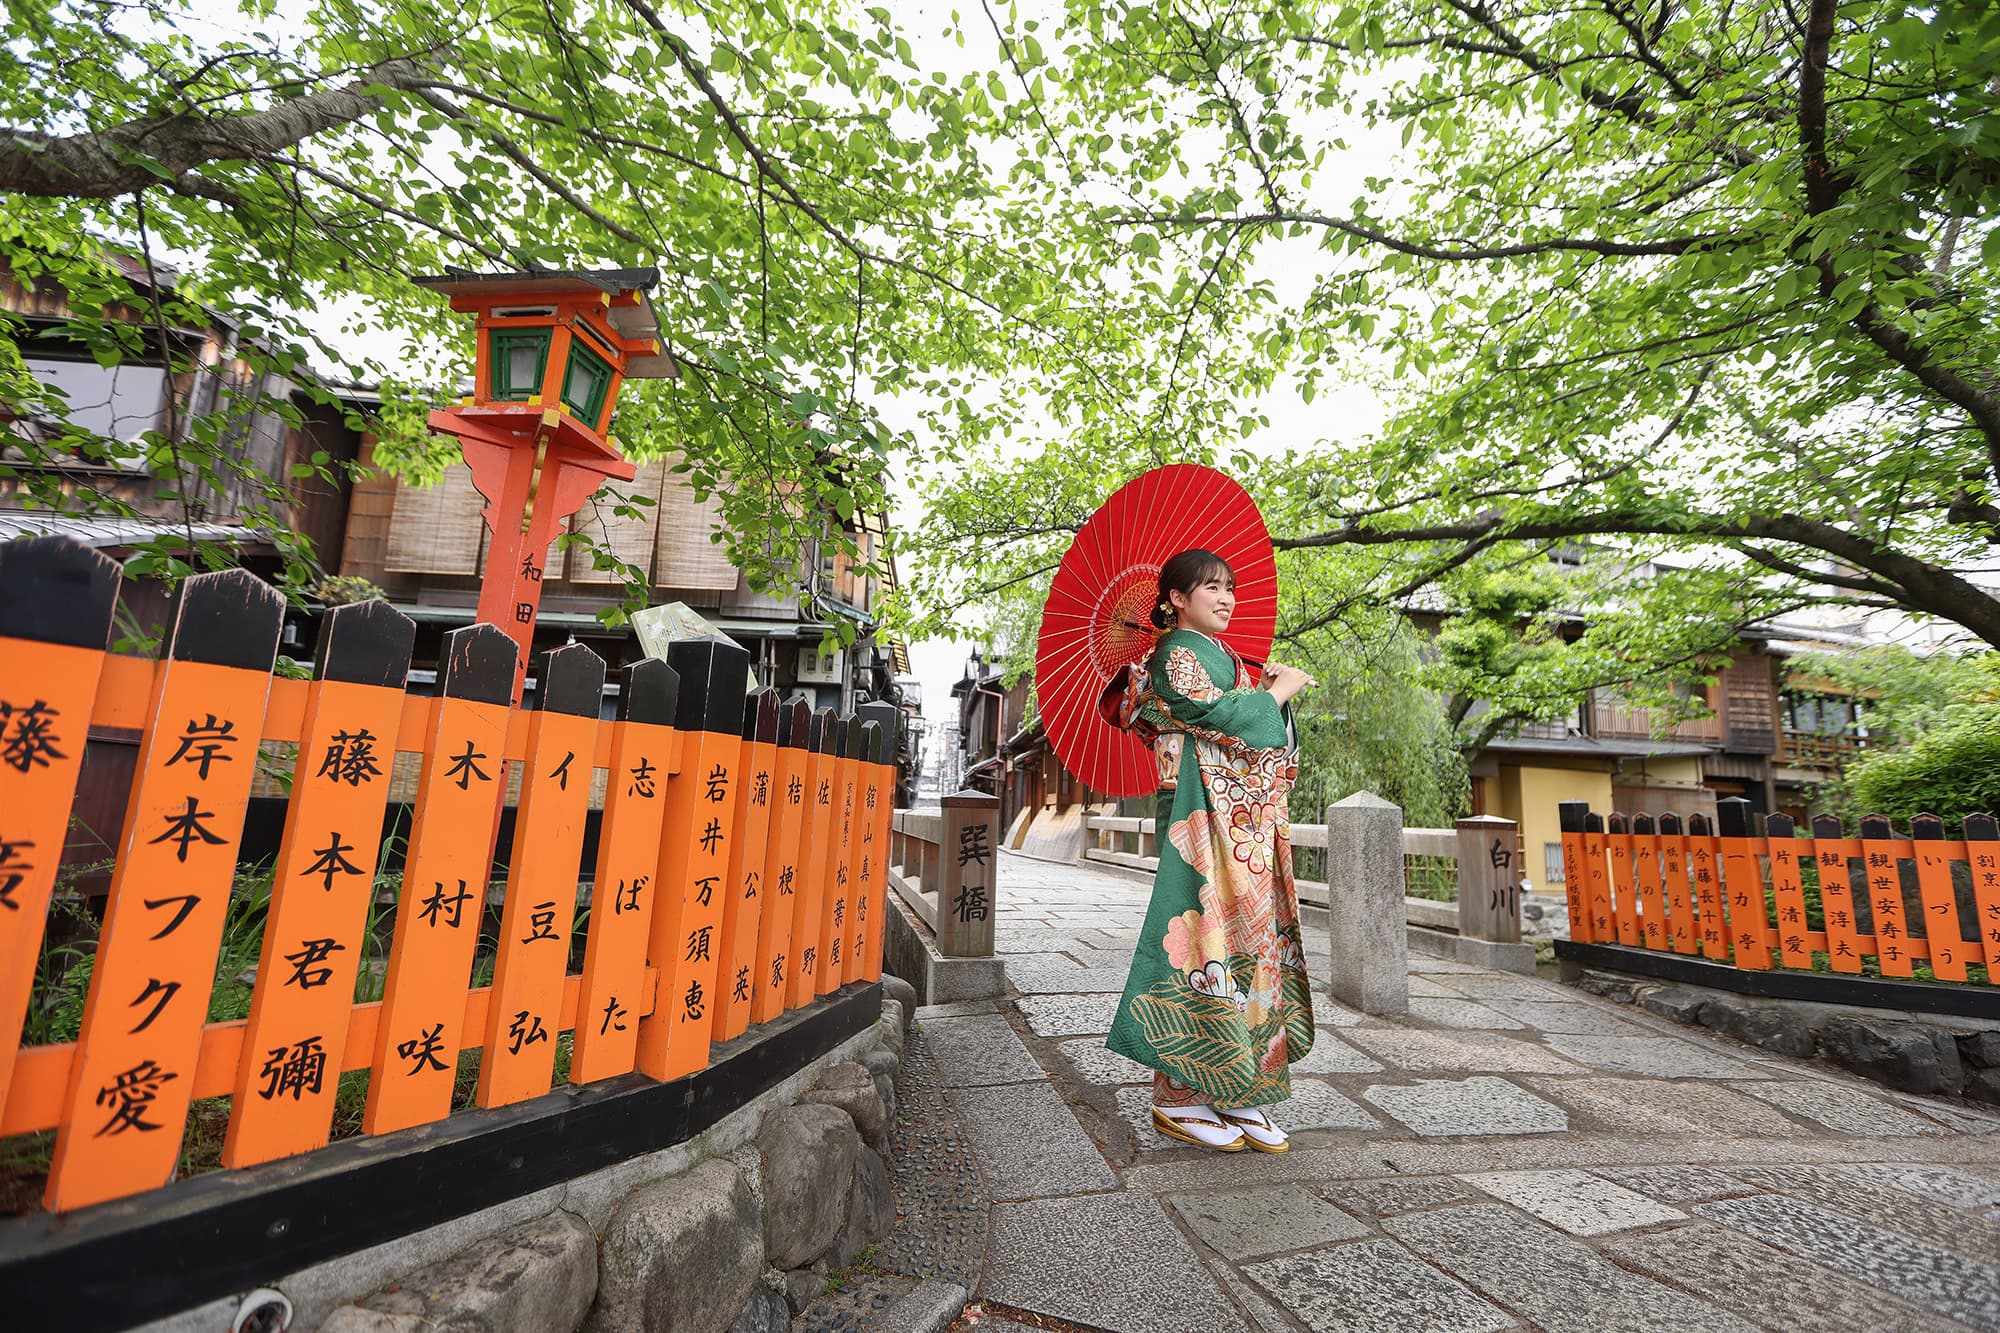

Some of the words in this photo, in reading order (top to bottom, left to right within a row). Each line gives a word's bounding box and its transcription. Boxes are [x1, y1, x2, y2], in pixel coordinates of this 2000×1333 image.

[92, 713, 239, 1139] 岸本フク愛
[257, 728, 384, 1101] 藤本君彌
[396, 740, 493, 1077] 木村咲
[508, 751, 576, 1056] イ豆弘
[600, 757, 657, 1036] 志ばた
[681, 763, 729, 1024] 岩井万須恵
[733, 770, 769, 1005] 蒲公英
[770, 773, 803, 989] 桔梗家
[802, 780, 830, 976] 佐野
[829, 859, 849, 967] 松葉屋
[952, 823, 992, 923] 巽橋
[1489, 838, 1514, 918] 白川
[1589, 843, 1608, 930] 美の八重
[1614, 847, 1630, 932] おいと
[1639, 847, 1660, 937] みの家
[1695, 847, 1719, 945] 今藤長十郎
[1727, 854, 1757, 951] 一力亭
[1776, 850, 1806, 955] 片山清愛
[1820, 852, 1855, 958] 観世淳夫
[1868, 852, 1904, 961] 観世安寿子
[1924, 855, 1953, 965] いづう
